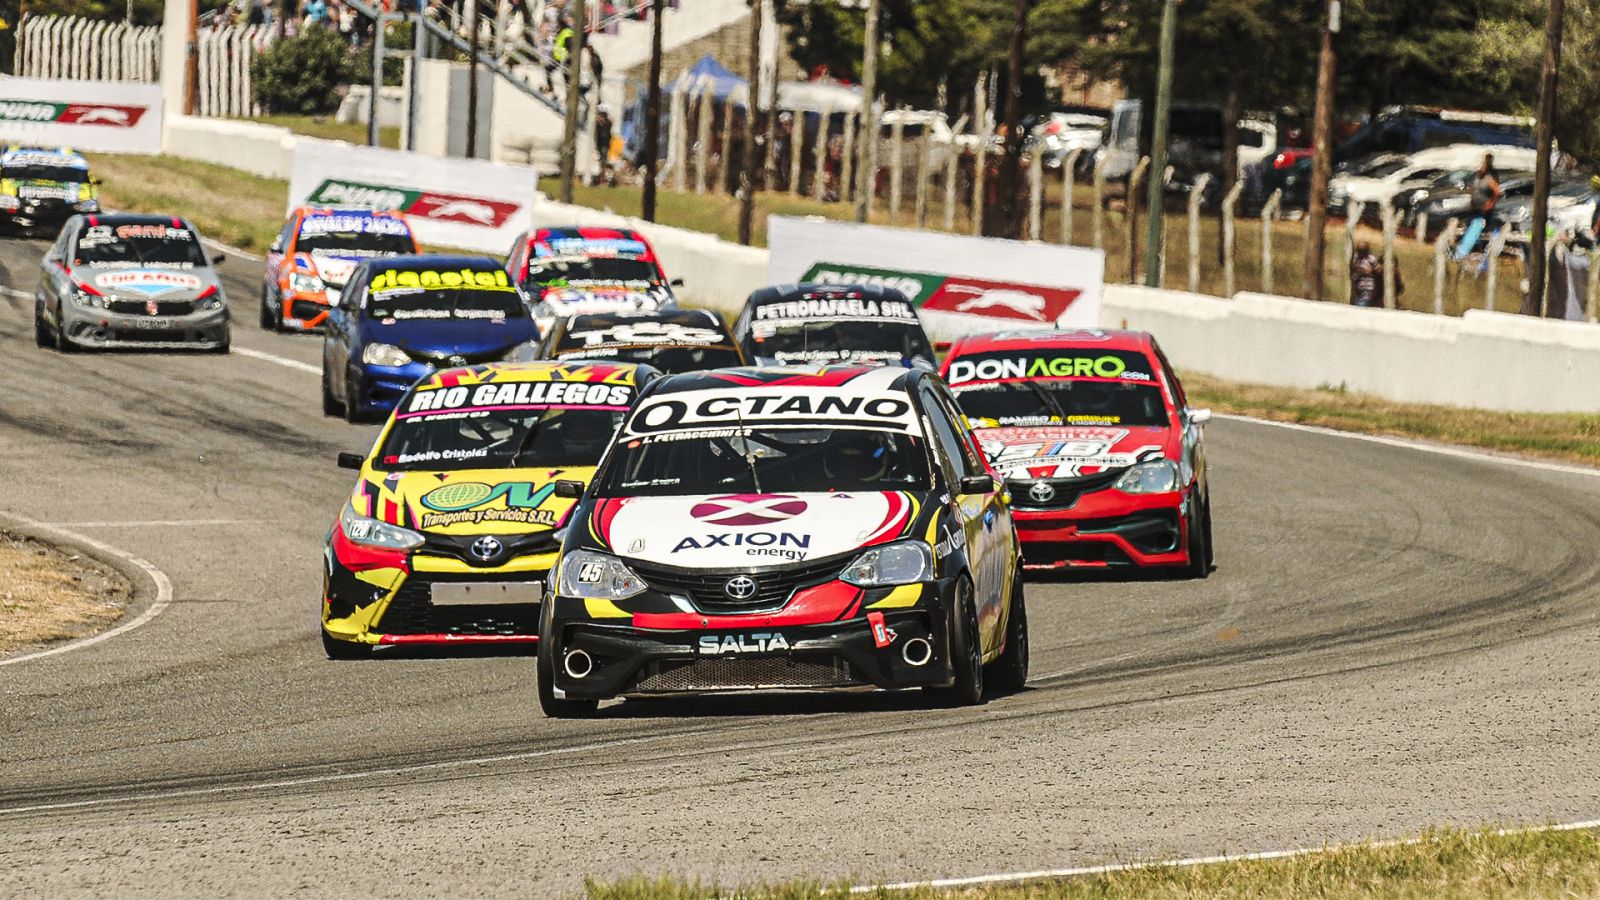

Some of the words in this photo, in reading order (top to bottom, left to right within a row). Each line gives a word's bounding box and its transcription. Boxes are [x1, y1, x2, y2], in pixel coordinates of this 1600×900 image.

[757, 300, 879, 320] PETRORAFAELA
[409, 386, 468, 412] RIO
[472, 383, 631, 406] GALLEGOS
[422, 510, 476, 527] Transportes
[485, 508, 528, 523] Servicios
[670, 531, 812, 554] AXION
[746, 548, 808, 561] energy
[581, 565, 602, 582] 45
[698, 633, 791, 656] SALTA
